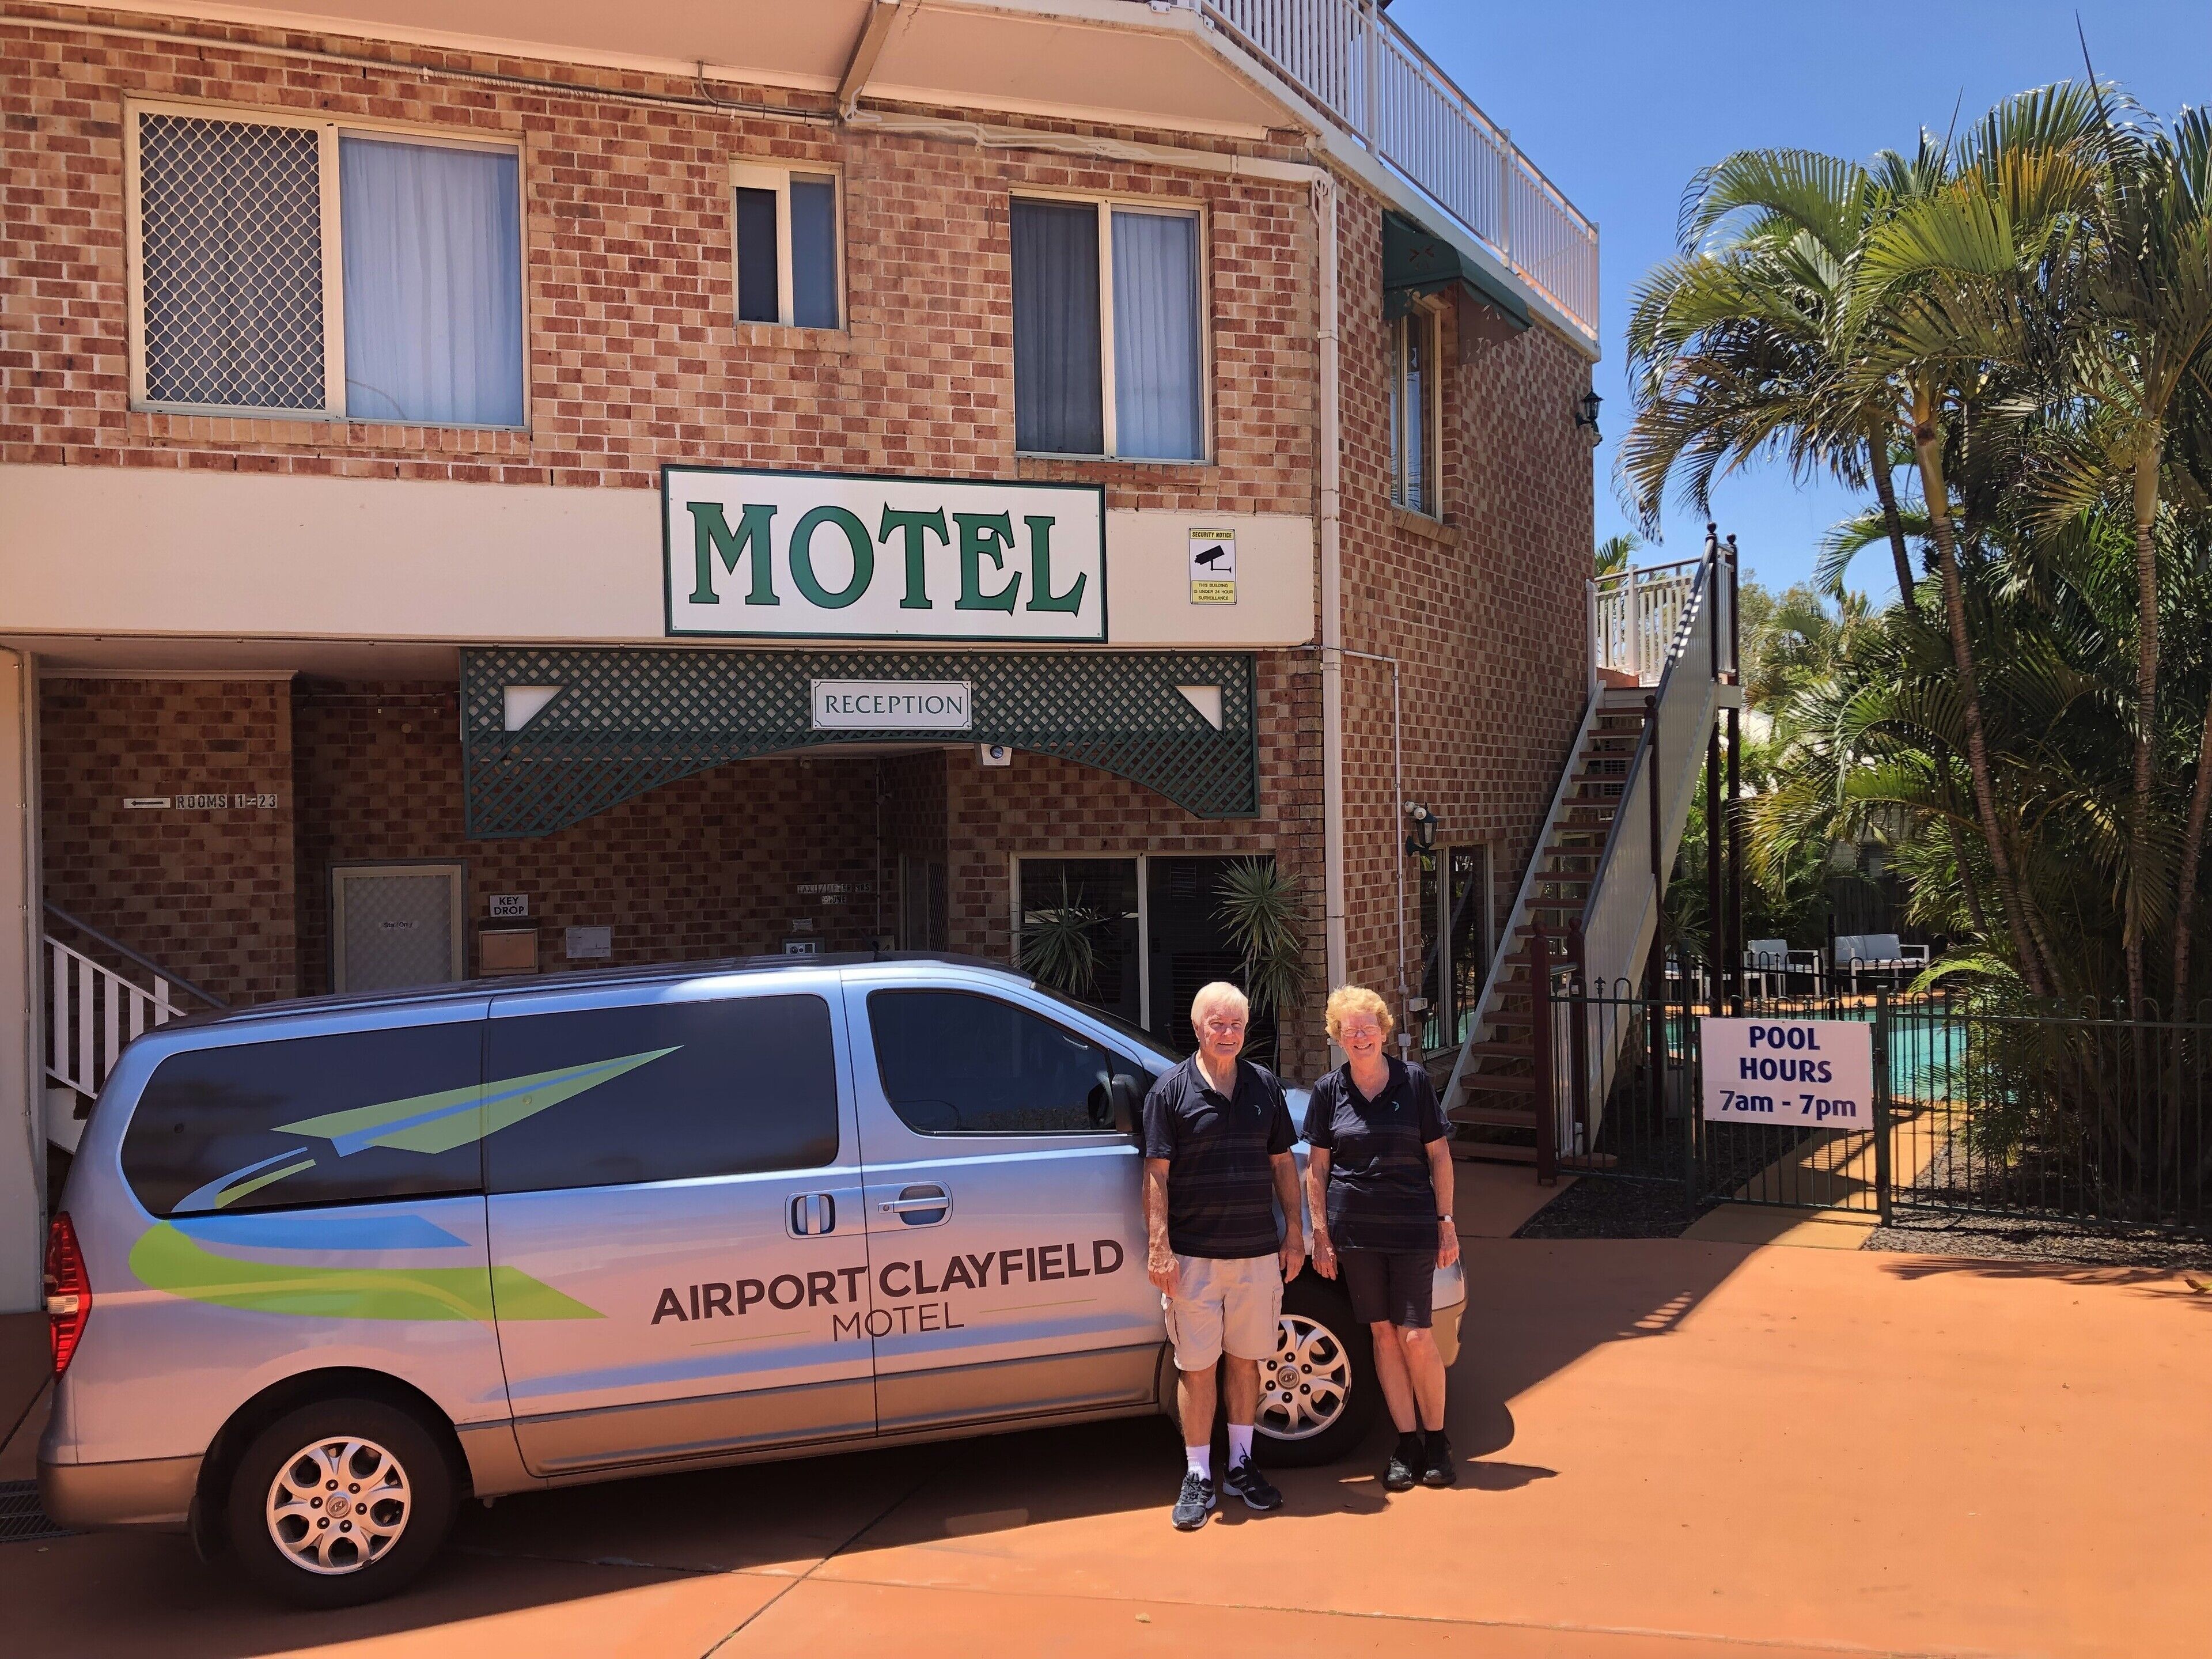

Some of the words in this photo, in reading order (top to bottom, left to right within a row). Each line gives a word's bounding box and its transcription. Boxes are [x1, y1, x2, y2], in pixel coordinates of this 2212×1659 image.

[687, 501, 1087, 618] MOTEL
[824, 695, 963, 715] RECEPTION
[177, 795, 226, 808] ROOMS
[494, 906, 525, 915] DROP
[499, 896, 520, 906] KEY
[1749, 1025, 1820, 1050] POOL
[1740, 1058, 1832, 1083] HOURS
[1719, 1090, 1774, 1112] 7am
[1799, 1094, 1856, 1120] 7pm
[650, 1266, 869, 1325] AIRPORT
[879, 1239, 1124, 1298] CLAYFIELD
[833, 1302, 964, 1342] MOTEL
